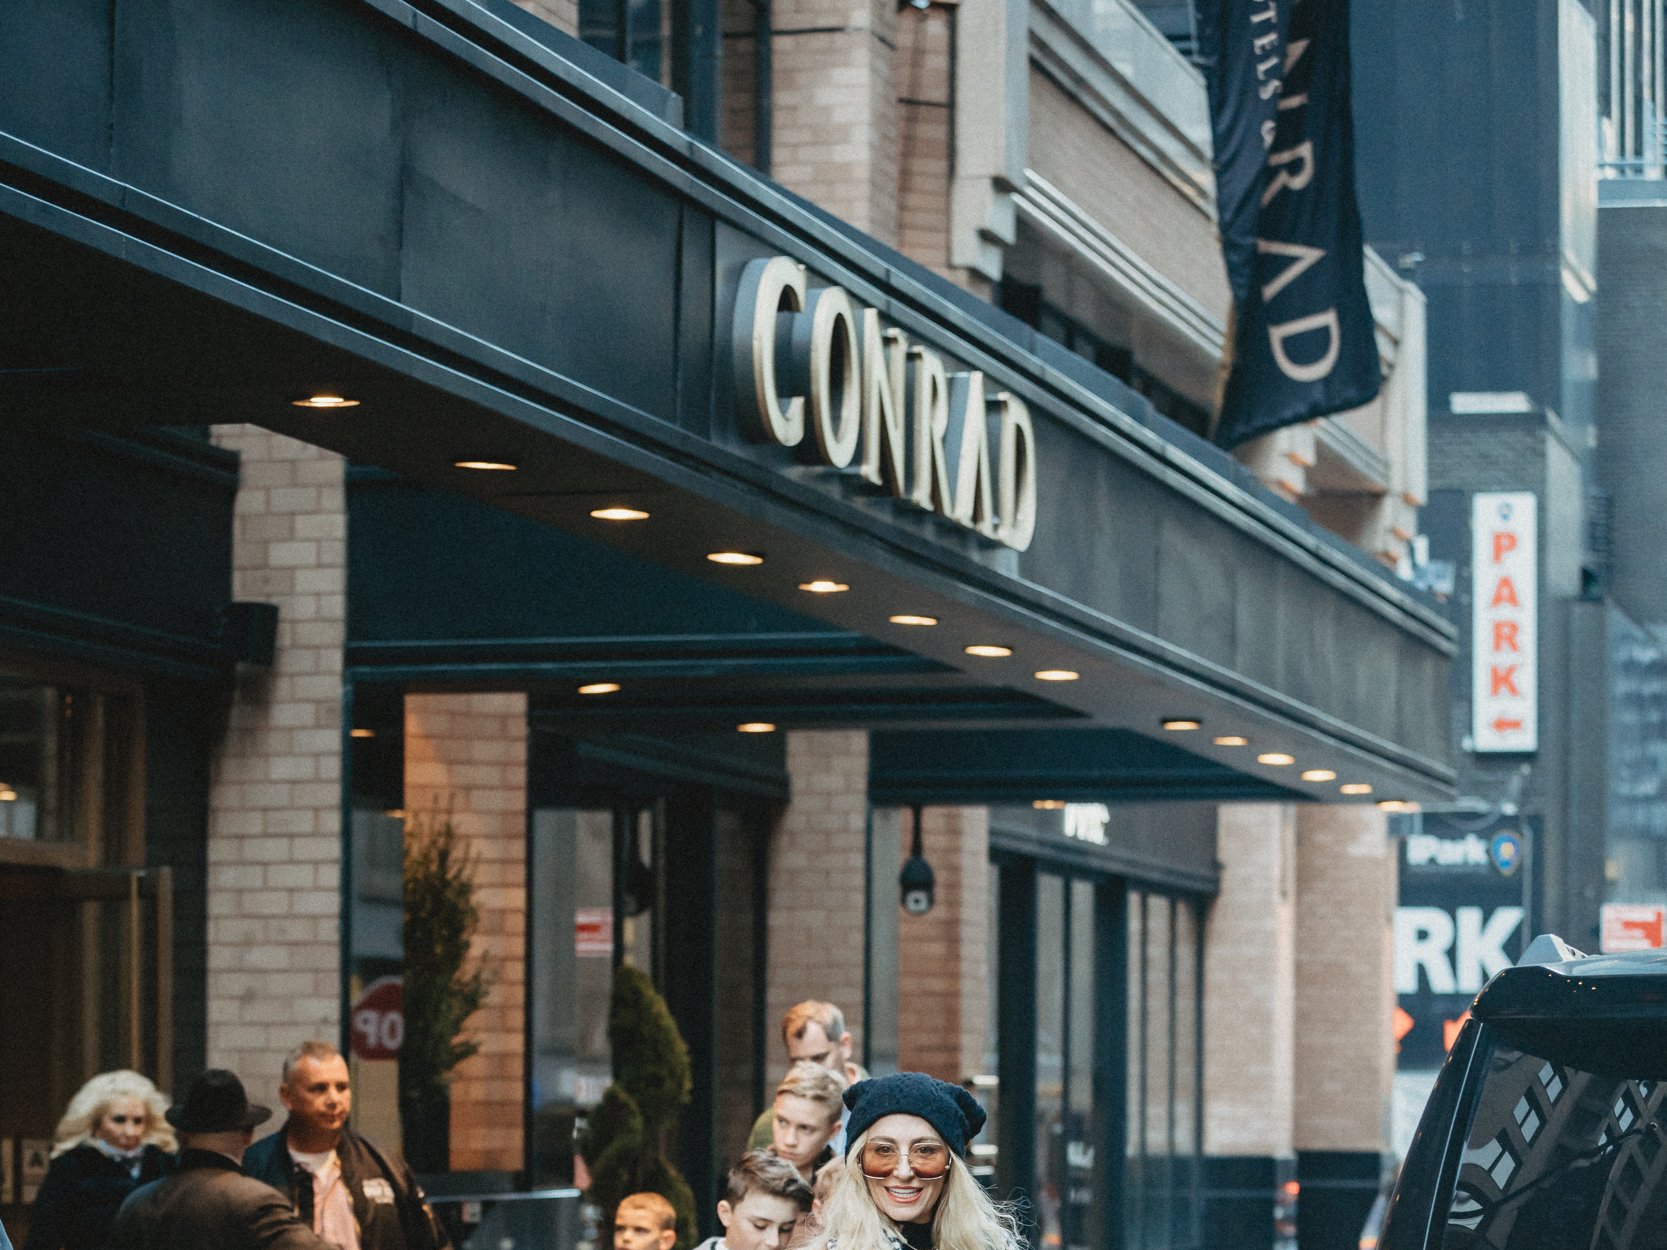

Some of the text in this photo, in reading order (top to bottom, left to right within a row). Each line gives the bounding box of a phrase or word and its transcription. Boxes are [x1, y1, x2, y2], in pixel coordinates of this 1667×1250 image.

[1250, 0, 1283, 100] TELS
[752, 255, 1037, 553] CONRAD
[1490, 531, 1521, 698] PARK
